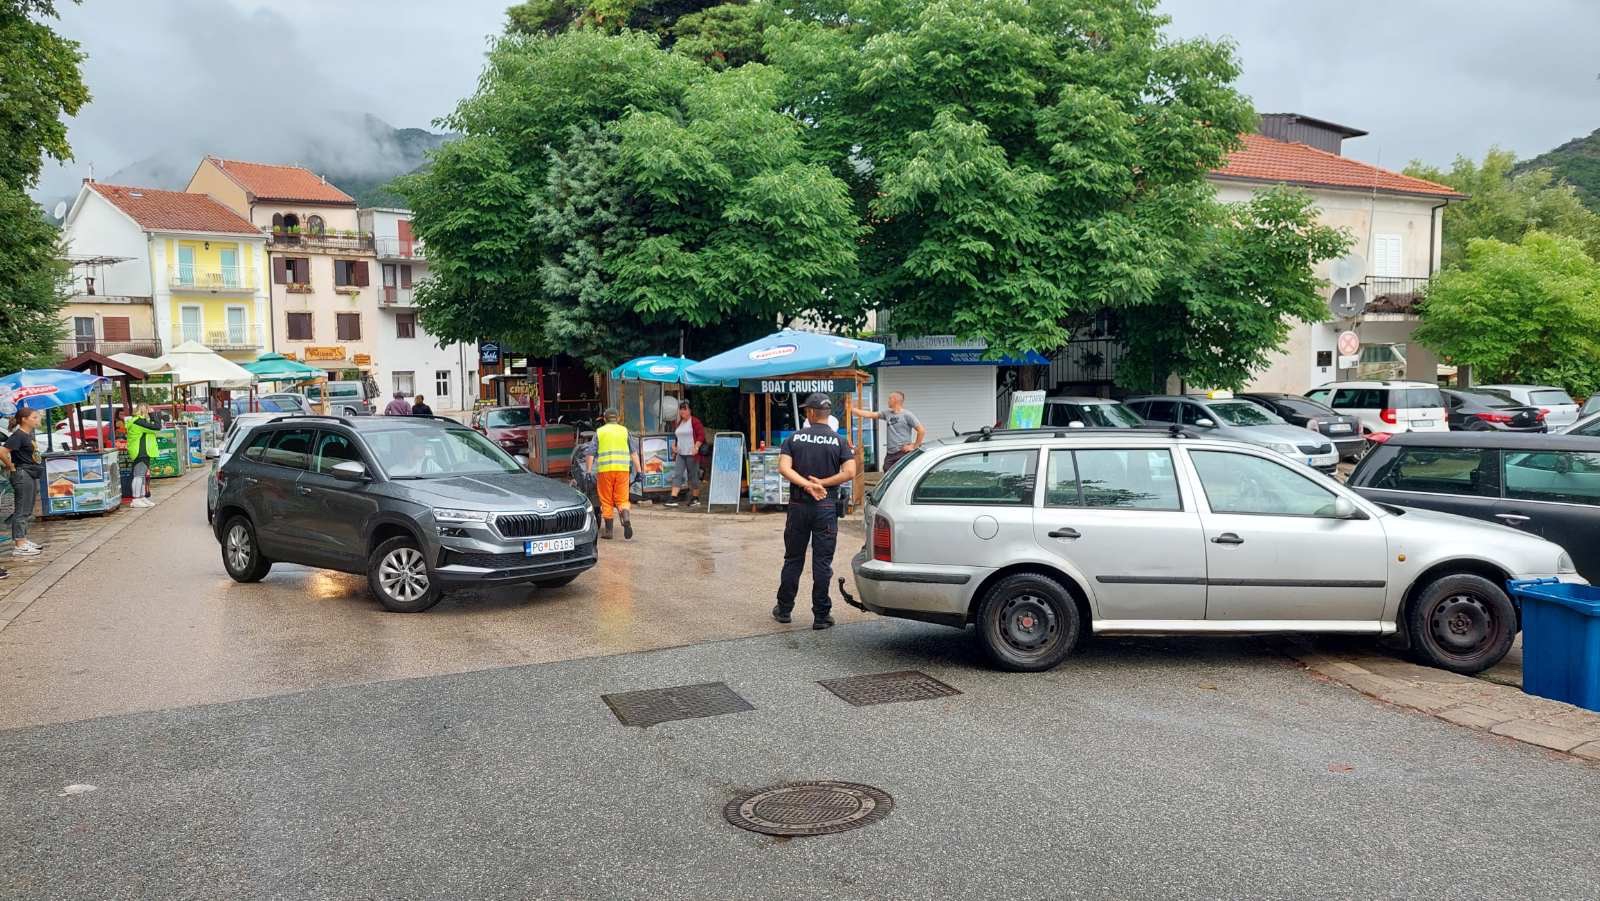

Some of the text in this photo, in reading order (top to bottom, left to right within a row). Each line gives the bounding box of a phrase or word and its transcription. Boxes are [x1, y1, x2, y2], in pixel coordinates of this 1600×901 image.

[761, 380, 834, 393] BOAT CRUISING
[792, 433, 840, 446] POLICIJA
